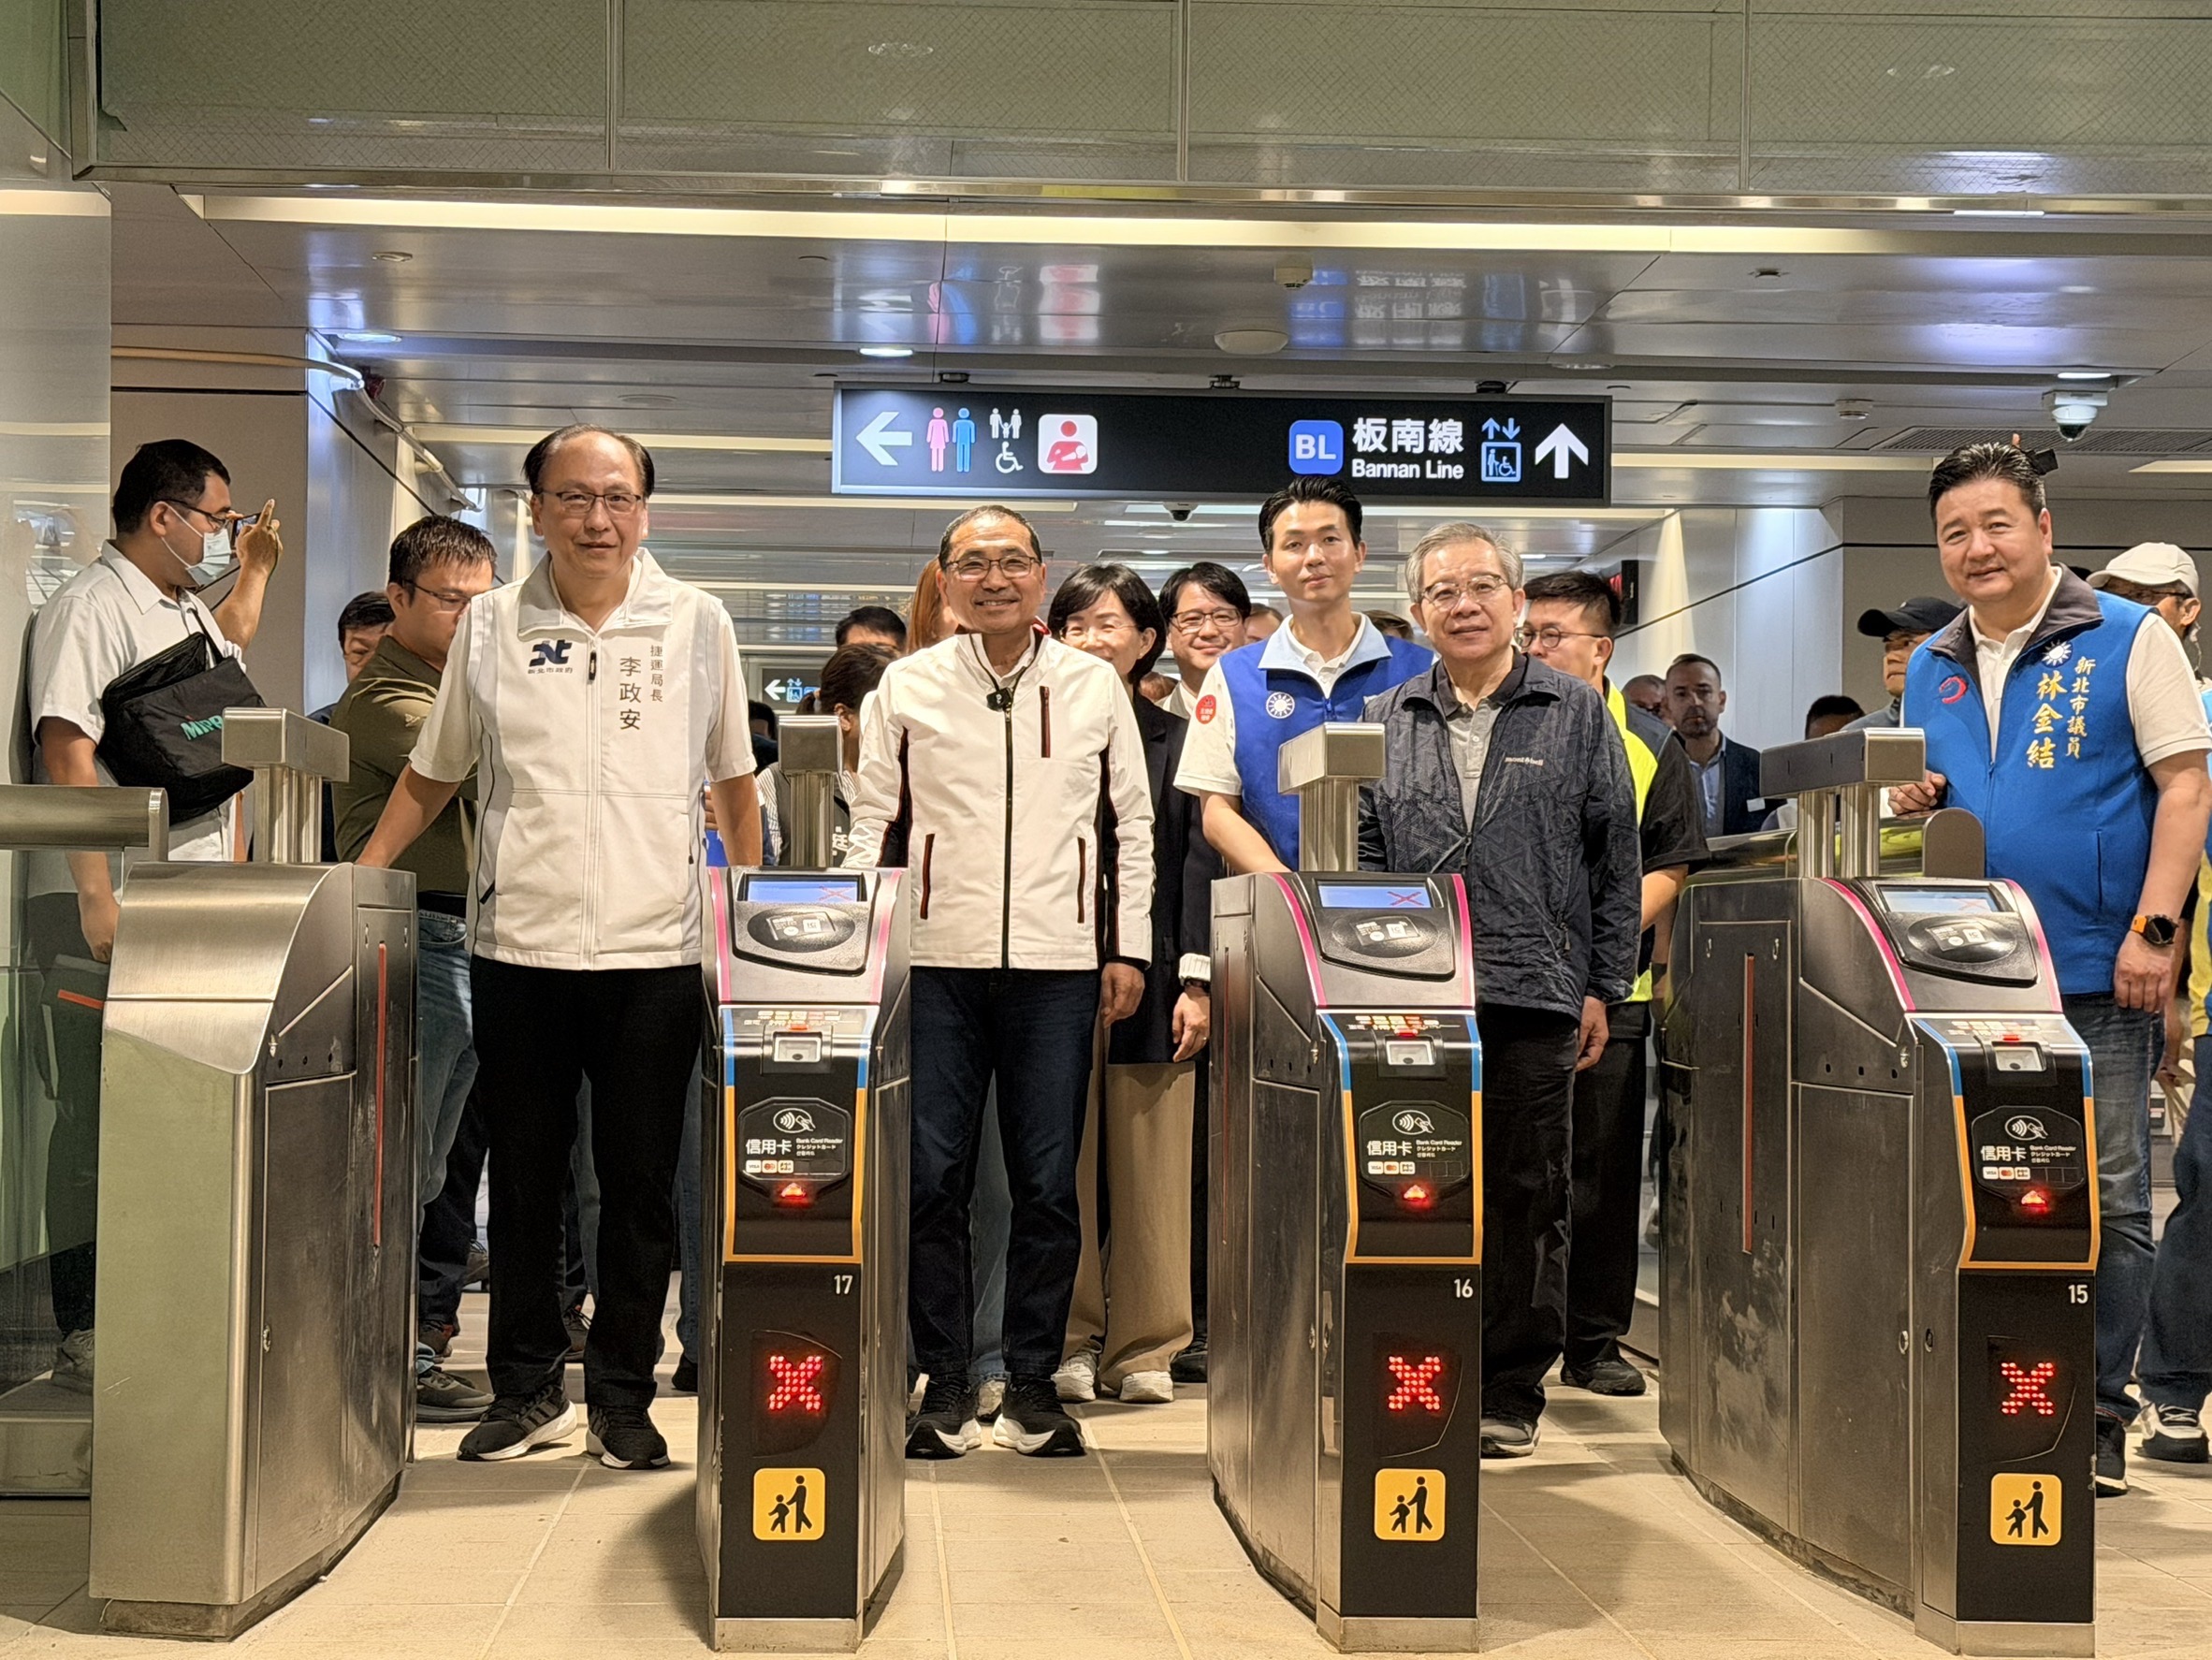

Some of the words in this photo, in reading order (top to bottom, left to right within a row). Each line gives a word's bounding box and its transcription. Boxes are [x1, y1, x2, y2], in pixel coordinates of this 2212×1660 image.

[1352, 417, 1464, 454] 板南線
[1295, 433, 1337, 459] BL
[1352, 459, 1420, 478] Bannan
[1425, 459, 1464, 479] Line
[649, 644, 663, 702] 捷運局長
[618, 656, 642, 730] 李政安
[2065, 656, 2096, 759] 新北市議員
[2026, 670, 2068, 768] 林金結
[746, 1139, 793, 1155] 信用卡
[1367, 1141, 1413, 1157] 信用卡
[1980, 1145, 2027, 1162] 信用卡
[834, 1274, 852, 1294] 17
[1453, 1278, 1473, 1298] 16
[2068, 1284, 2088, 1303] 15
